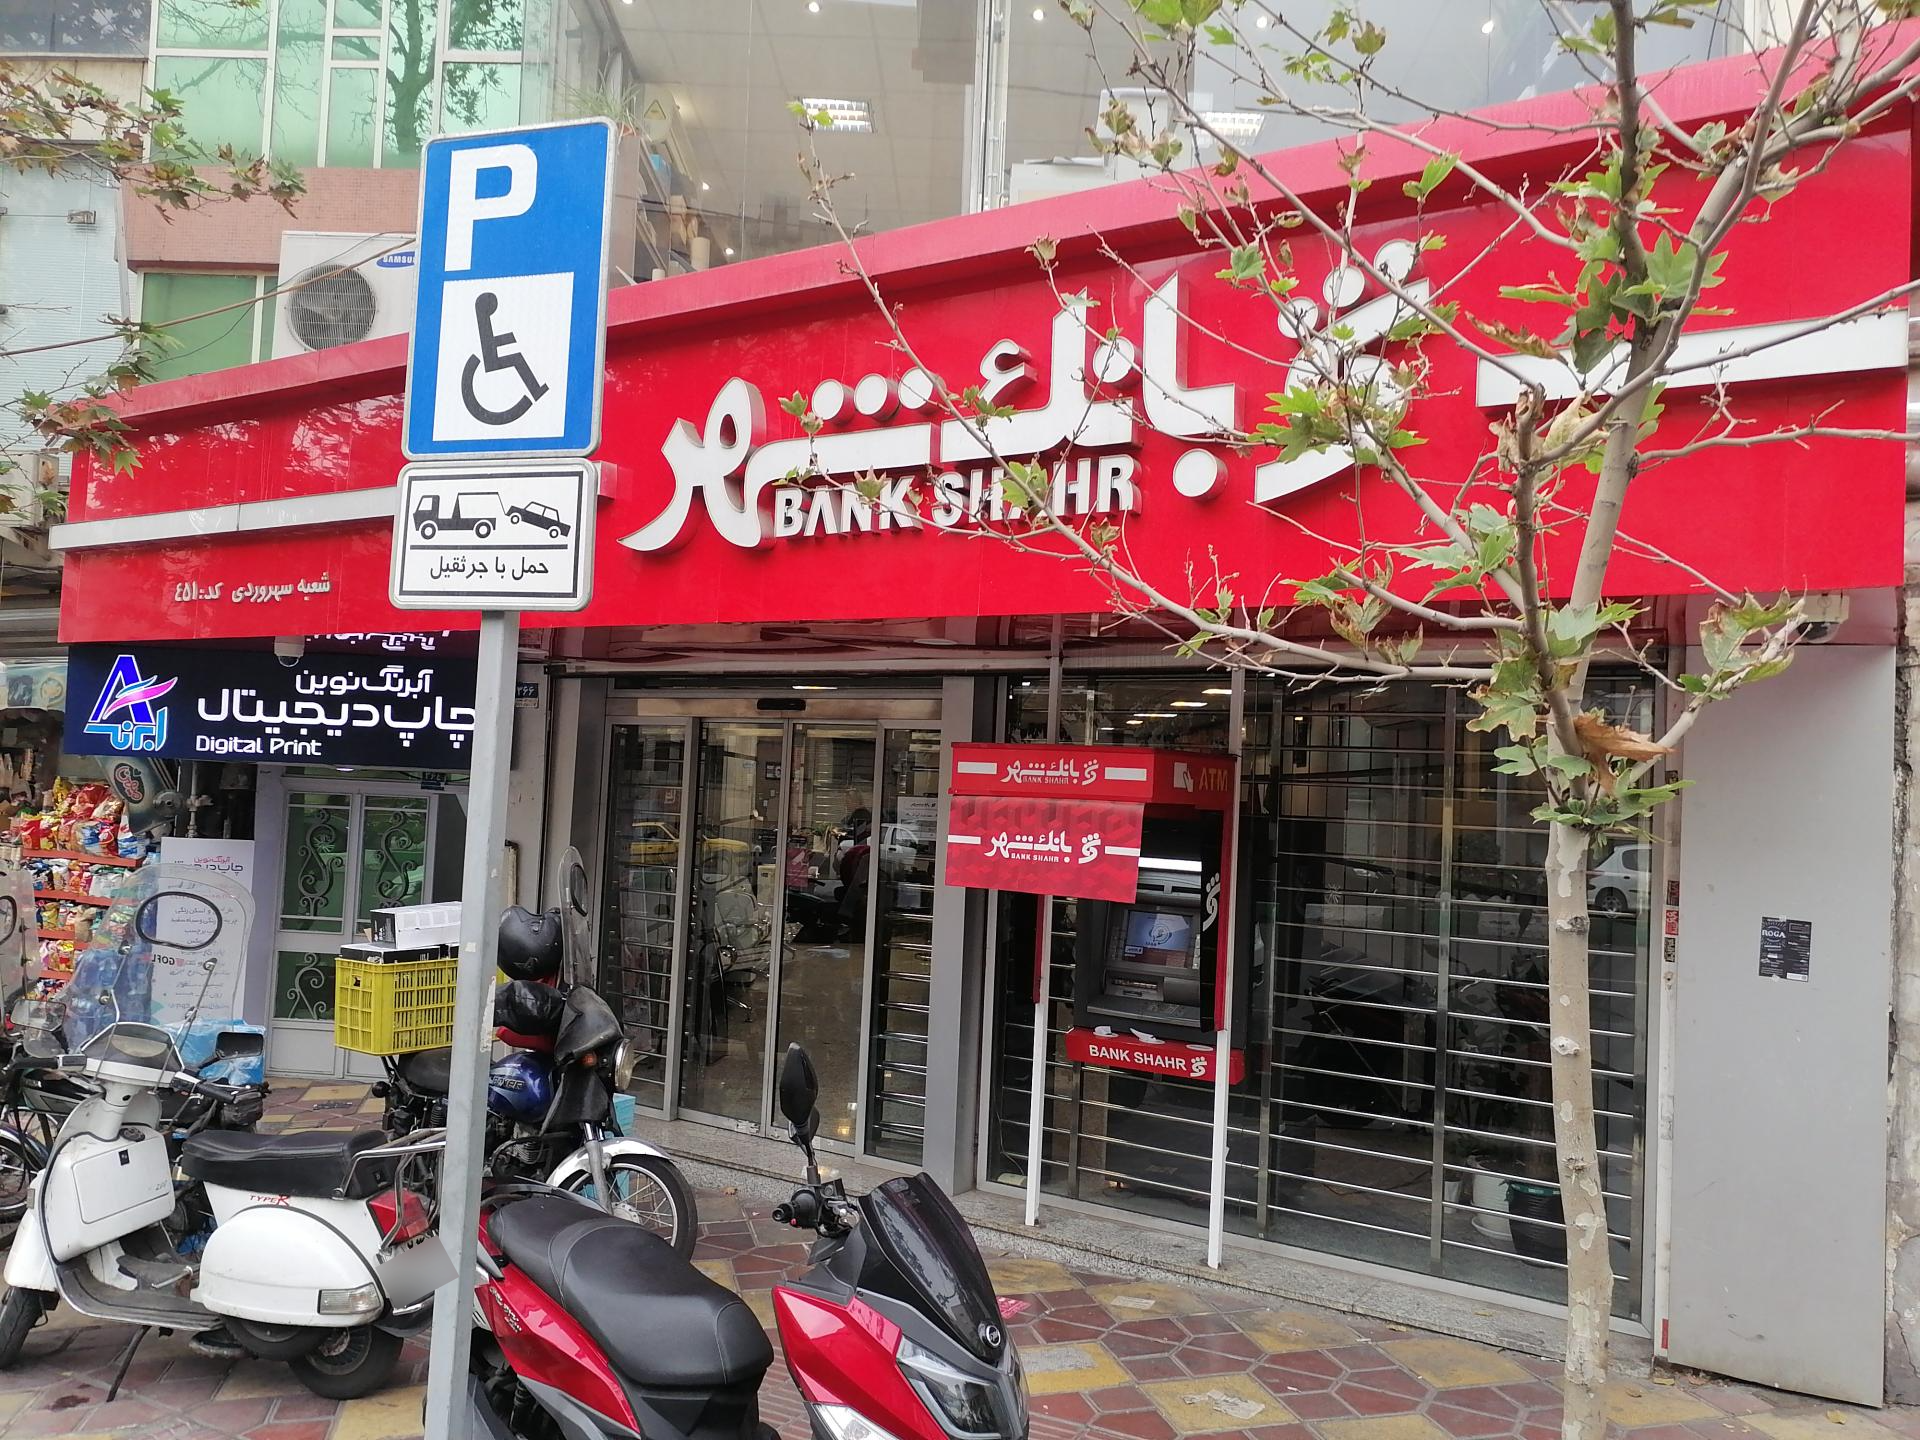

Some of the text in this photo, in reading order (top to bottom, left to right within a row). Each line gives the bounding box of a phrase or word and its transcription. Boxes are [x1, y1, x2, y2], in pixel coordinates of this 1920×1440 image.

[444, 143, 538, 272] P
[382, 255, 415, 263] SAMSU
[775, 475, 916, 537] BANK
[430, 555, 549, 581] حمل با جرثقیل
[231, 582, 294, 602] سهروردی
[297, 572, 331, 600] شعبه
[295, 669, 360, 696] نوین
[198, 688, 475, 749] چاپ دیجیتال
[195, 735, 322, 756] Digital Print
[1199, 767, 1228, 791] ATM
[1089, 1044, 1187, 1071] BANK SHAHR
